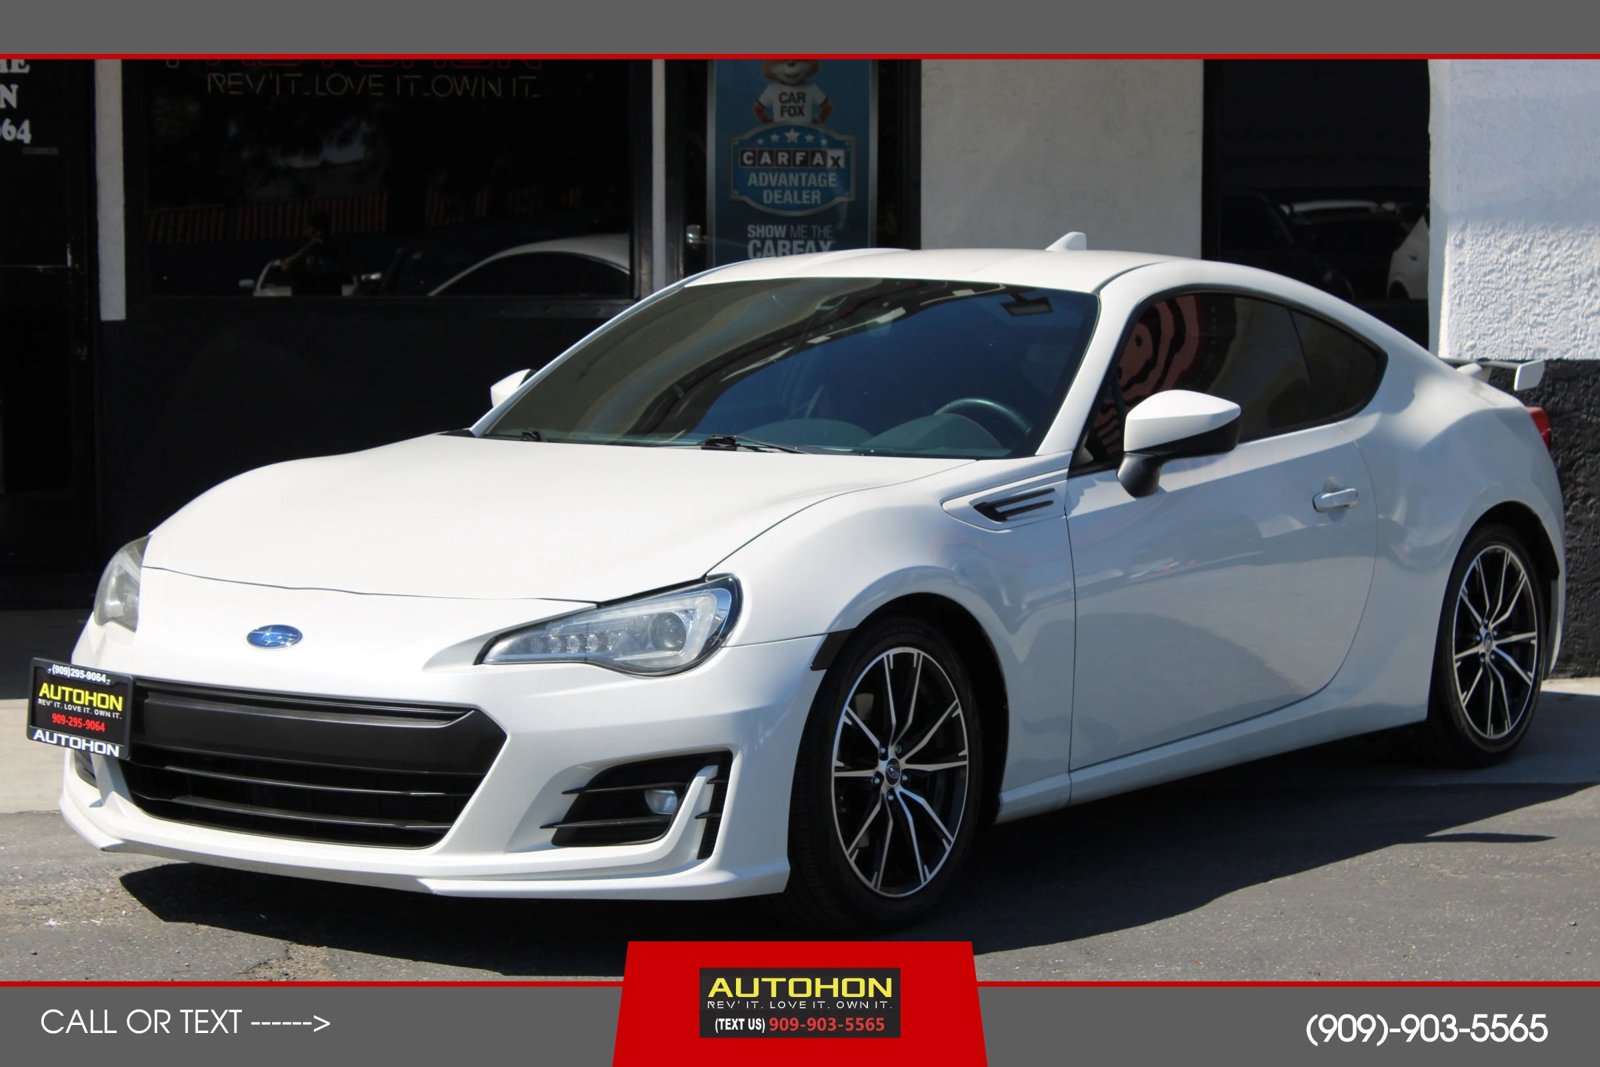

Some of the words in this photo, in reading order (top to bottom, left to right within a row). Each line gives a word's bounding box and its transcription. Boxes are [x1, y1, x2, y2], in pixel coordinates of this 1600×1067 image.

[315, 73, 384, 97] LOVE
[431, 74, 502, 97] OWN
[779, 92, 806, 104] CAR
[780, 105, 805, 117] FOX
[742, 151, 841, 168] CARFAX
[747, 172, 838, 187] ADVANTAGE
[762, 189, 821, 204] DEALER
[747, 224, 786, 238] SHOW
[790, 225, 808, 239] ME
[811, 225, 833, 239] THE
[39, 682, 123, 711] AUTOHON
[64, 704, 82, 713] LOVE
[94, 709, 111, 718] OWN
[51, 713, 106, 732] 909-295-9064
[33, 729, 120, 757] AUTOHON
